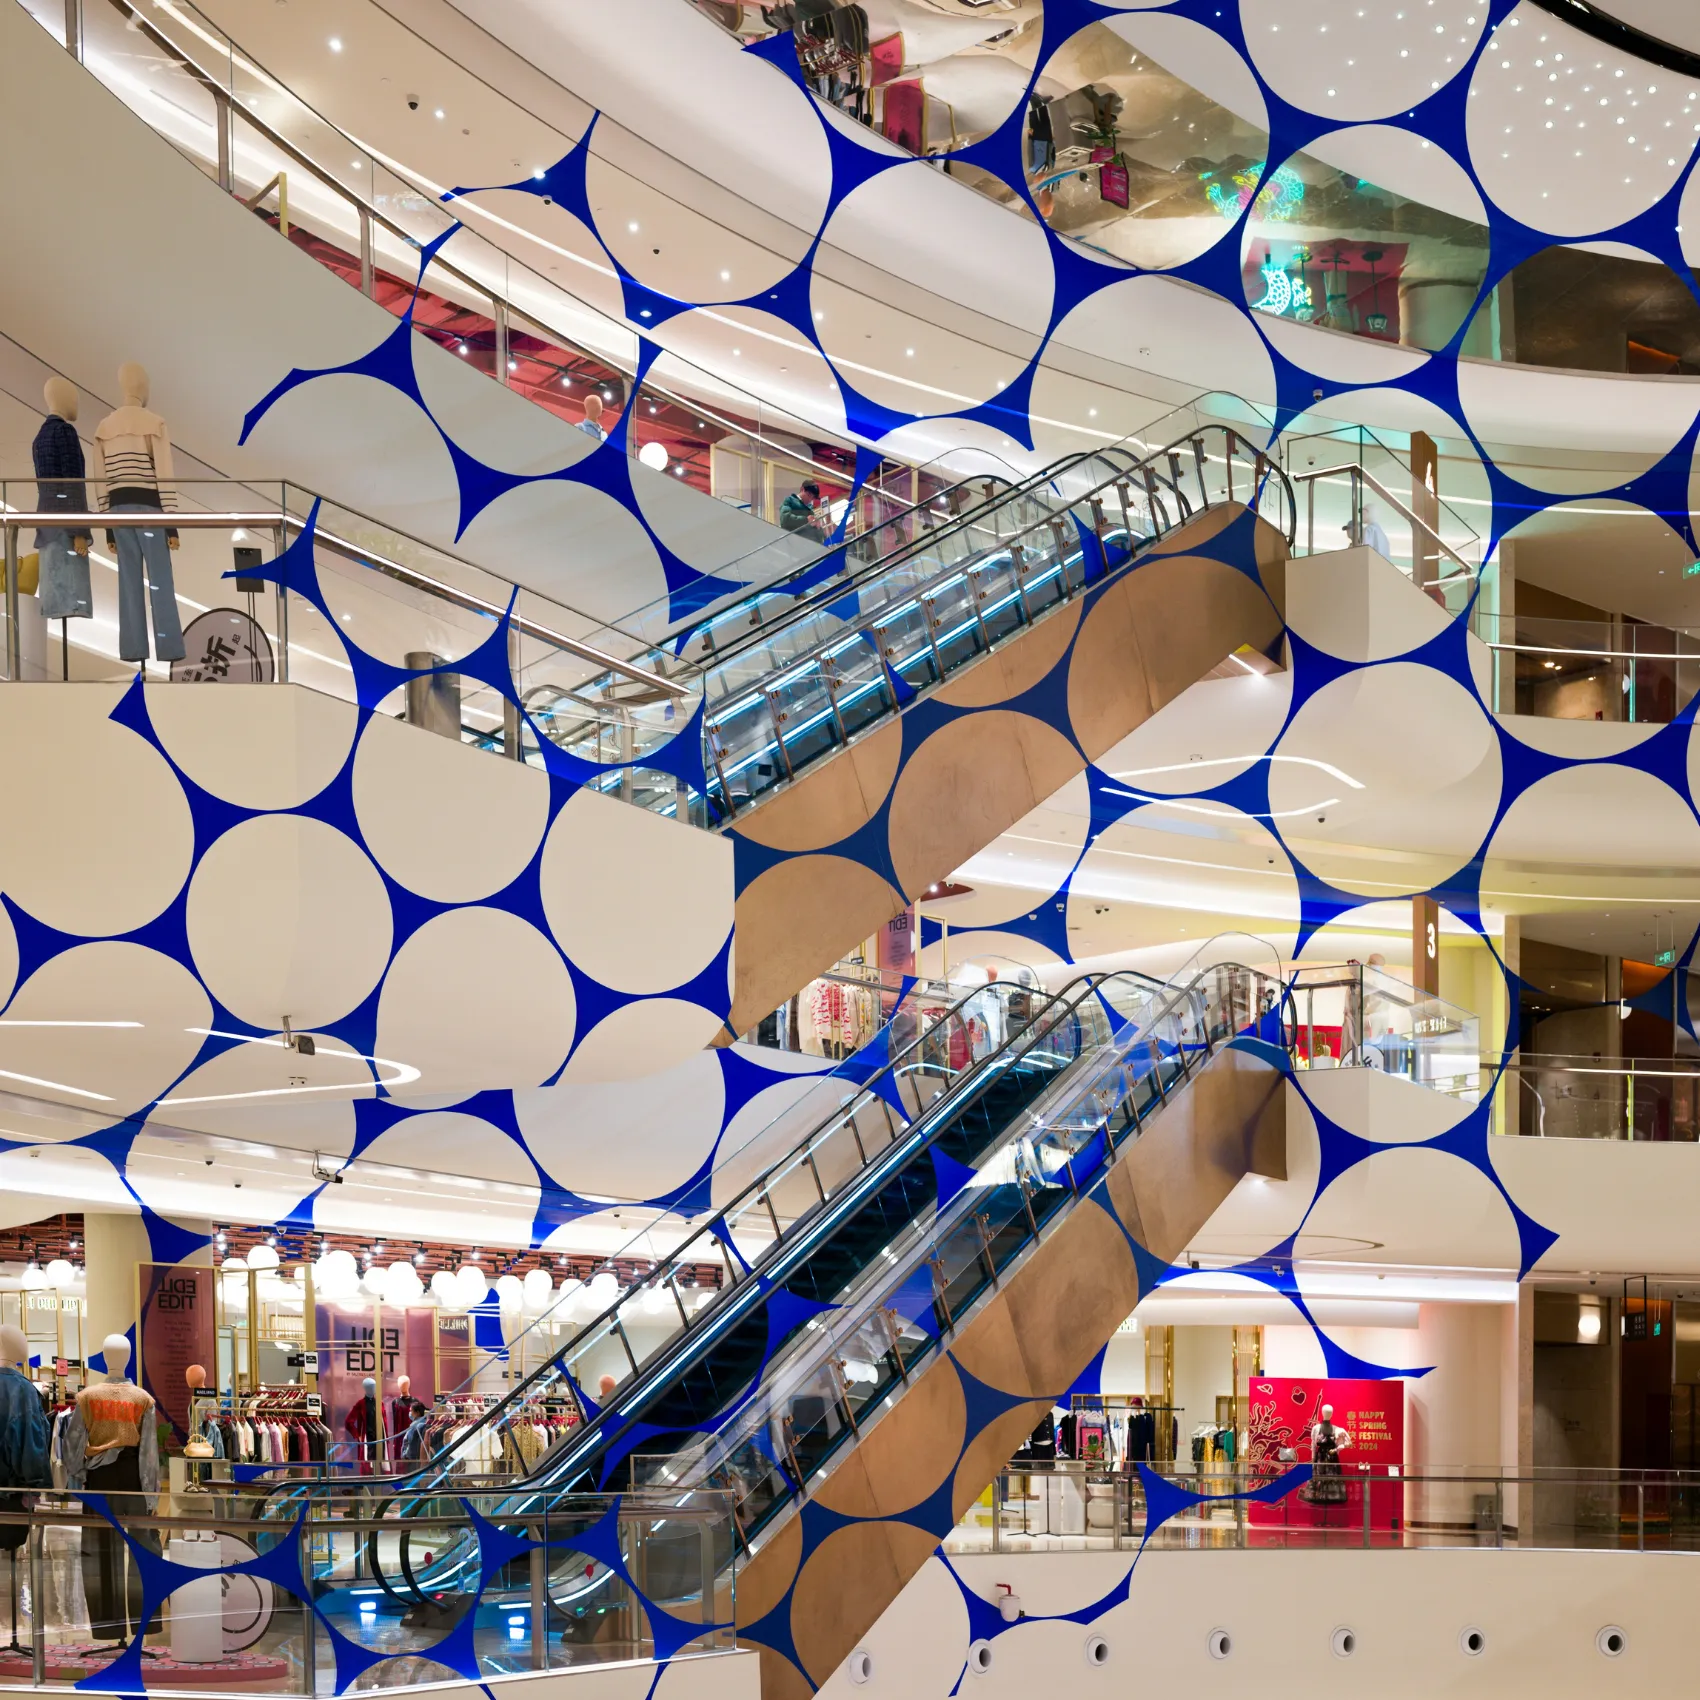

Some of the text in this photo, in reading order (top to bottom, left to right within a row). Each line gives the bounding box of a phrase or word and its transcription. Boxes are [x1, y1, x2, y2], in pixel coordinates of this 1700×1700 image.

[1425, 461, 1435, 499] 4
[1427, 922, 1436, 958] 3
[157, 1277, 196, 1294] EDIT
[157, 1294, 196, 1309] EDIT
[345, 1326, 399, 1349] EDIT
[346, 1350, 399, 1372] EDIT
[1358, 1411, 1384, 1420] HAPPY
[1358, 1421, 1386, 1430] SPRING
[1358, 1431, 1392, 1440] FESTIVAL
[1358, 1442, 1378, 1450] 2024
